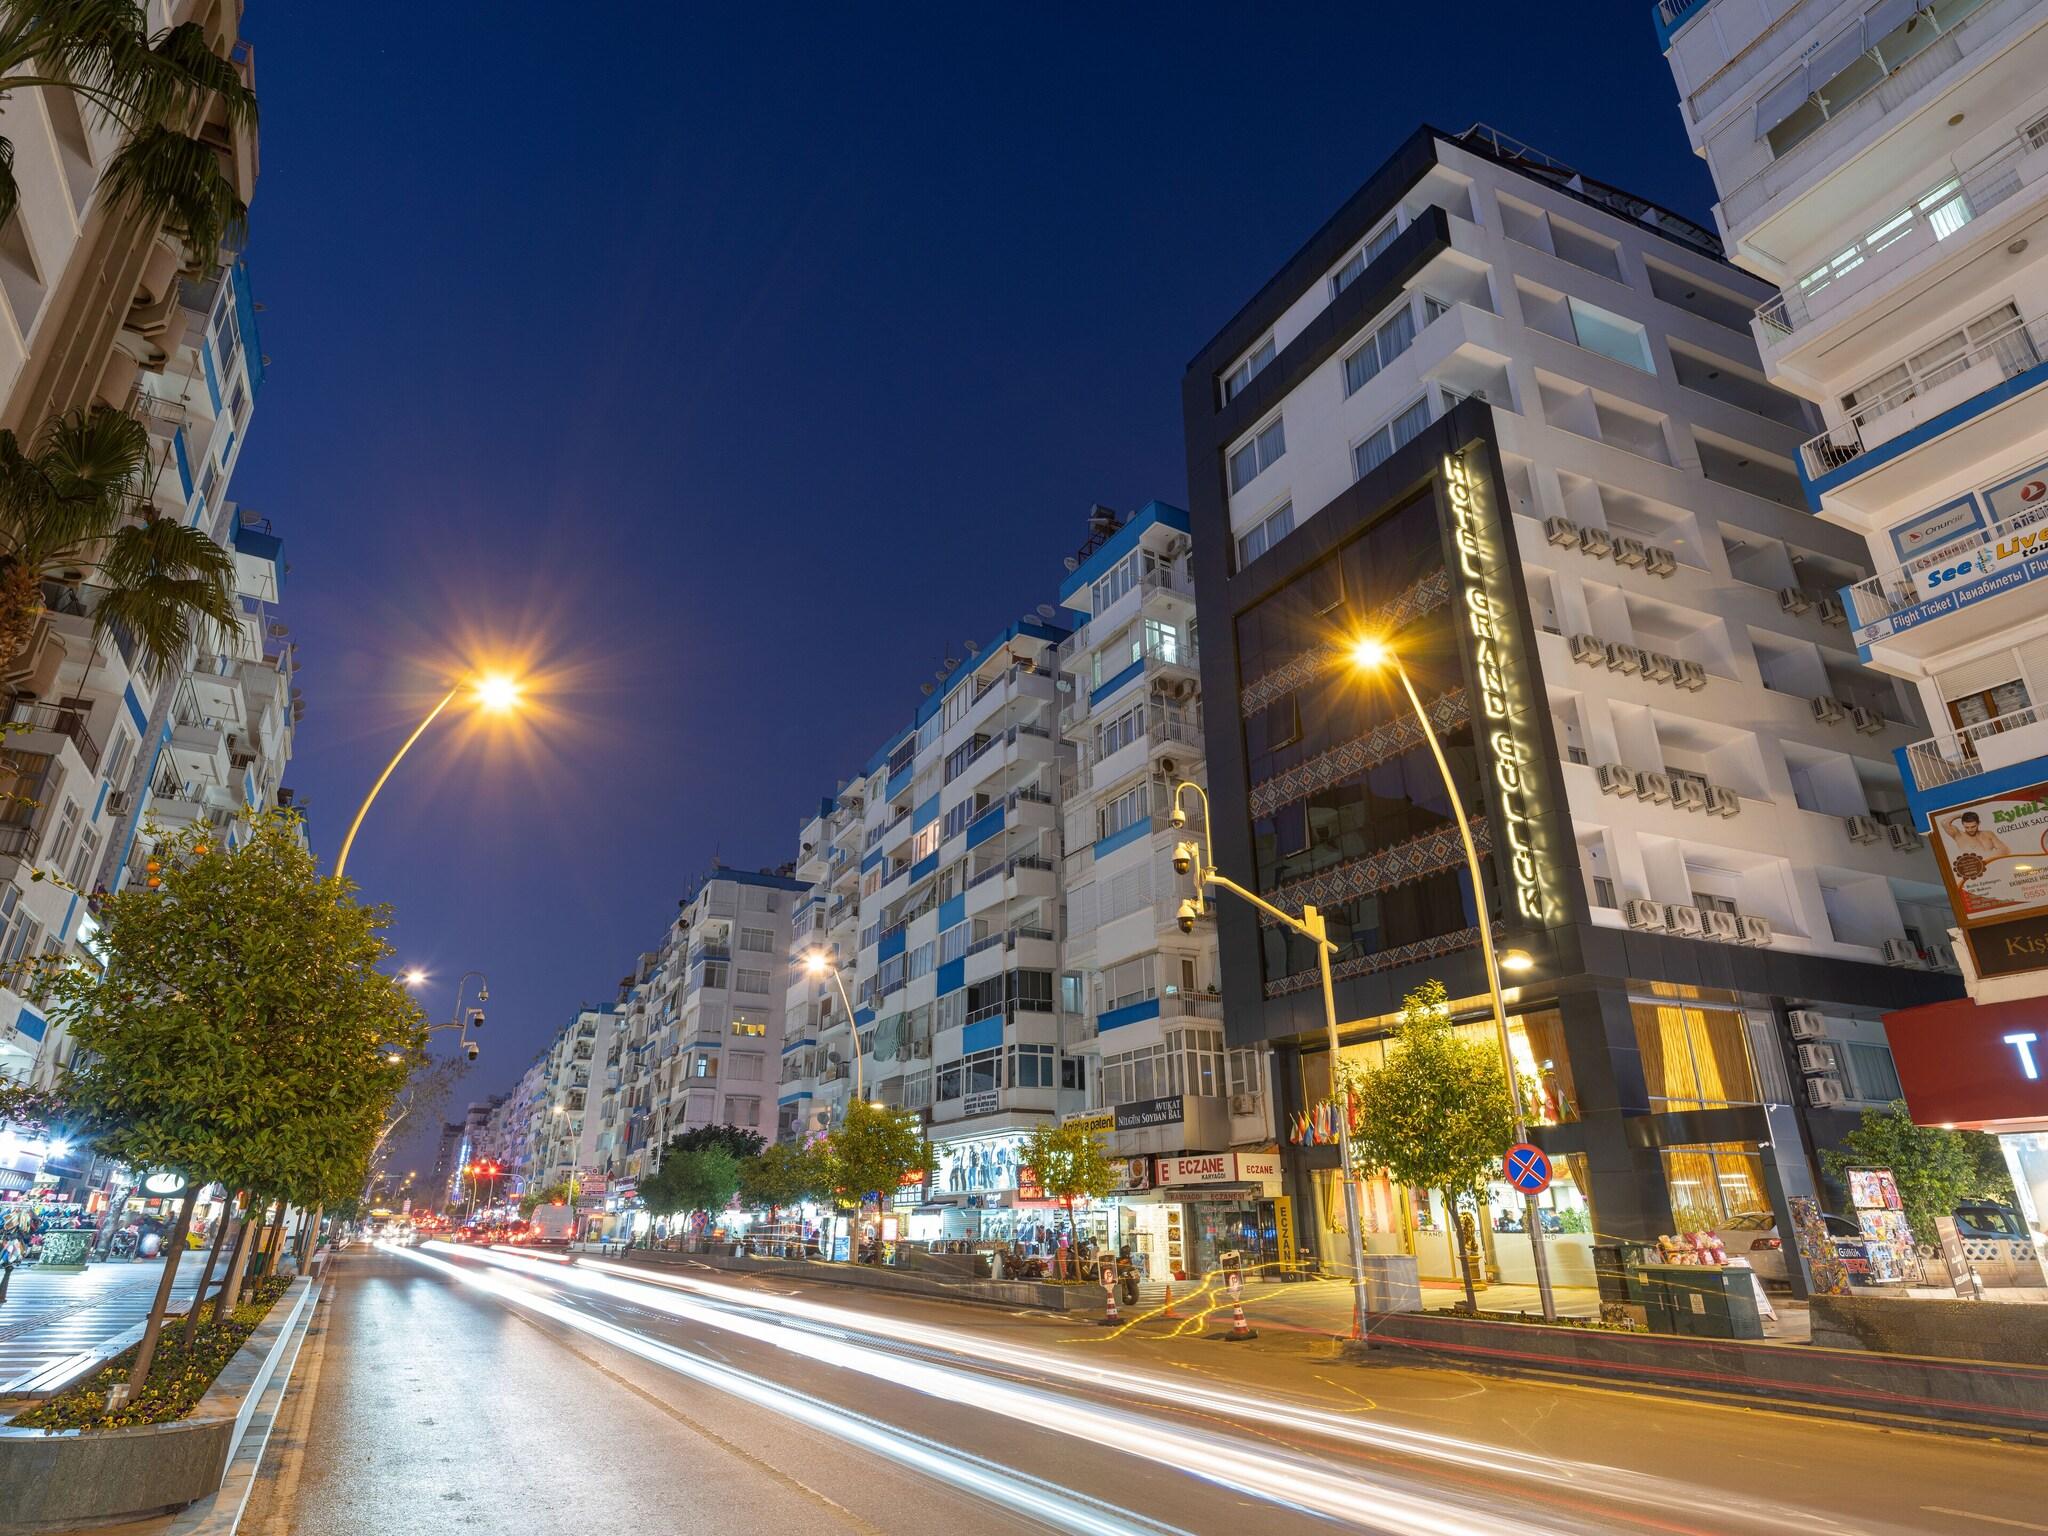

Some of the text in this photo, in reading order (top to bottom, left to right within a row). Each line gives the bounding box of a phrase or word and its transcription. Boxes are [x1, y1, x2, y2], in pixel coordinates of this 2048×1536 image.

[1928, 560, 1973, 588] See
[1996, 527, 2048, 560] Live
[2030, 559, 2048, 574] Flu
[1444, 454, 1484, 579] HOTEL
[1465, 587, 1505, 719] GRAND
[1959, 571, 2023, 603] Авиабилеты
[1892, 597, 1952, 629] Flight Ticket
[2003, 1033, 2038, 1079] T
[1141, 1111, 1167, 1124] SOYDAN
[1168, 1109, 1181, 1120] BAL
[1154, 1099, 1181, 1111] AVUKAT
[1090, 1115, 1114, 1132] patent
[1161, 1157, 1225, 1182] E ECZANE
[1246, 1165, 1274, 1175] ECZANE
[1280, 1206, 1293, 1272] ECZANE
